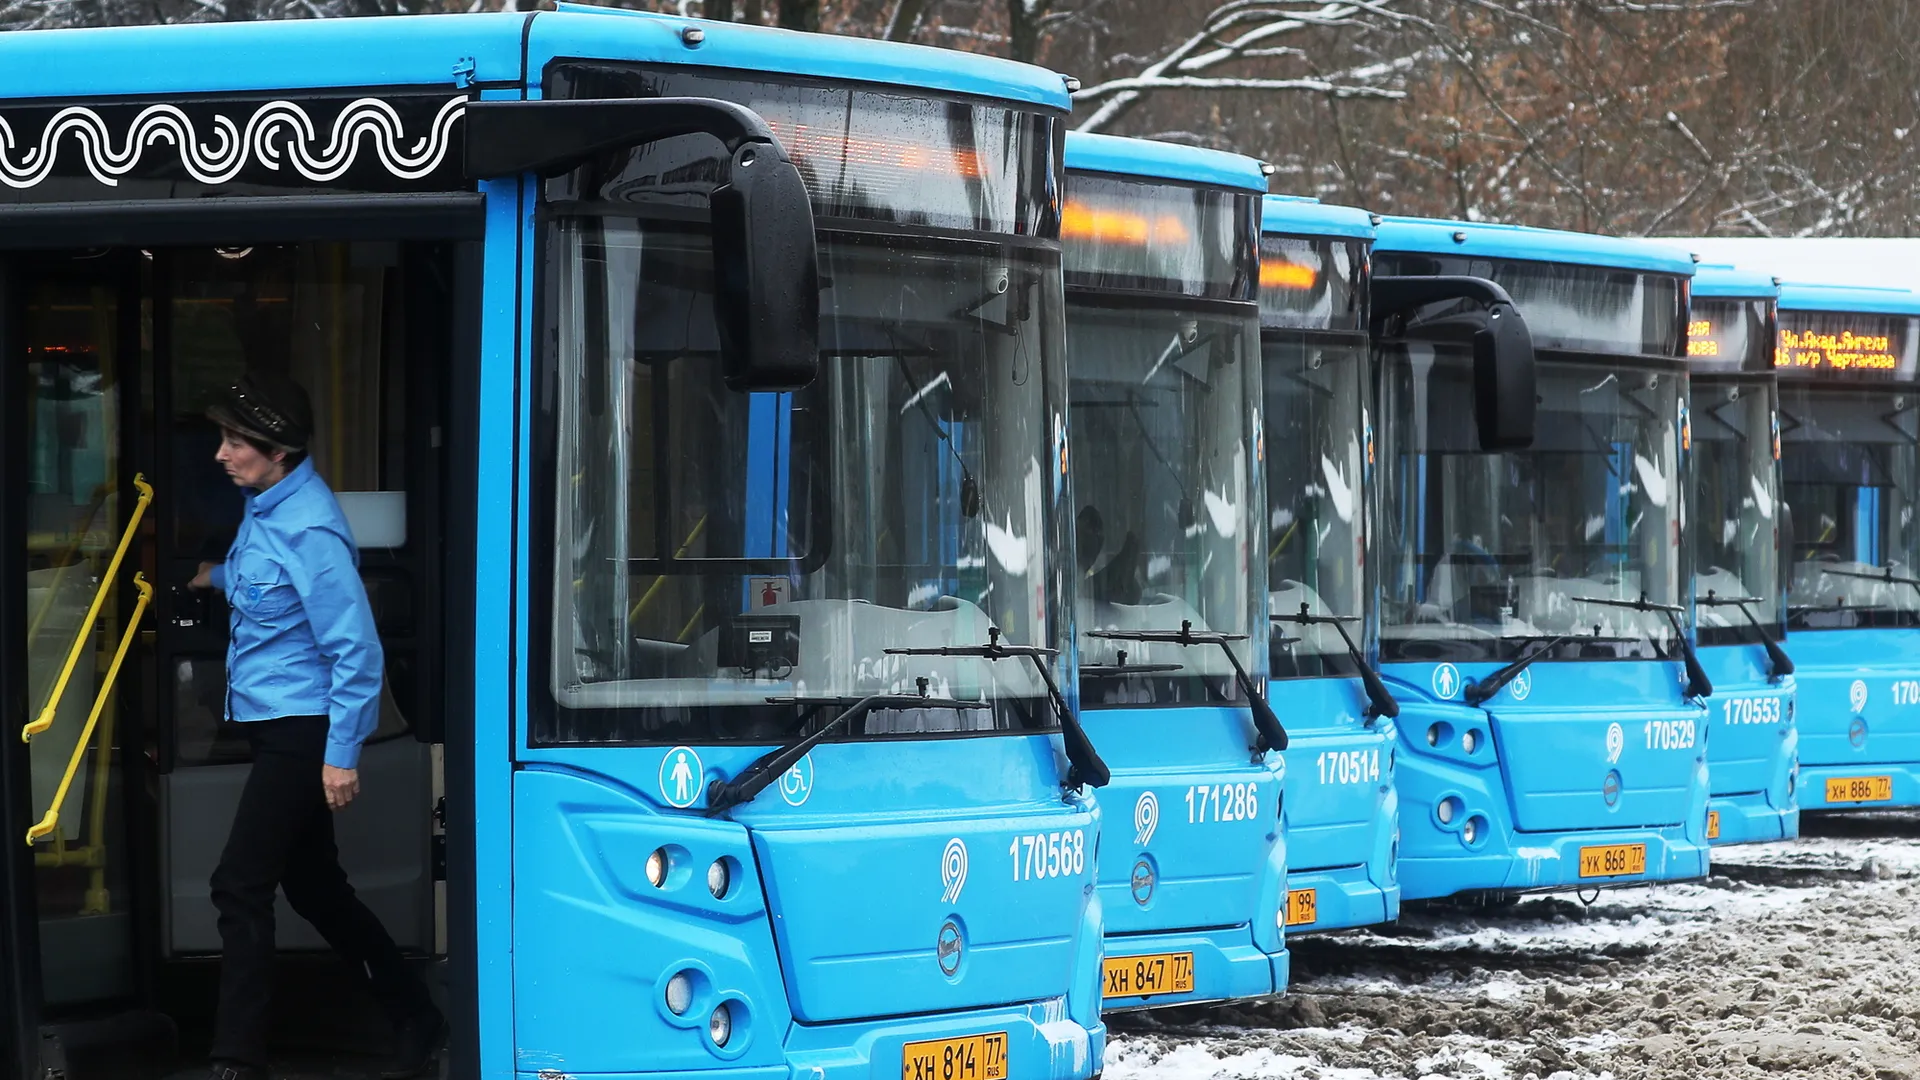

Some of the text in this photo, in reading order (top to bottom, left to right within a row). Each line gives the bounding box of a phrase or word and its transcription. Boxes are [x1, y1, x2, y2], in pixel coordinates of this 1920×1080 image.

[1891, 681, 1920, 705] 170
[1723, 697, 1781, 725] 170553
[1644, 719, 1696, 751] 170529
[1317, 750, 1380, 785] 170514
[1851, 780, 1871, 798] 886
[1878, 778, 1888, 792] 77
[1185, 782, 1258, 824] 171286
[1009, 829, 1084, 881] 170568
[1604, 849, 1626, 872] 868
[1632, 847, 1642, 864] 77
[1298, 892, 1311, 913] 99
[1135, 960, 1165, 990] 847
[1173, 956, 1188, 979] 77
[1175, 980, 1187, 989] RUS
[943, 1042, 976, 1080] 814
[985, 1037, 1002, 1065] 77
[986, 1066, 1000, 1077] RUS
